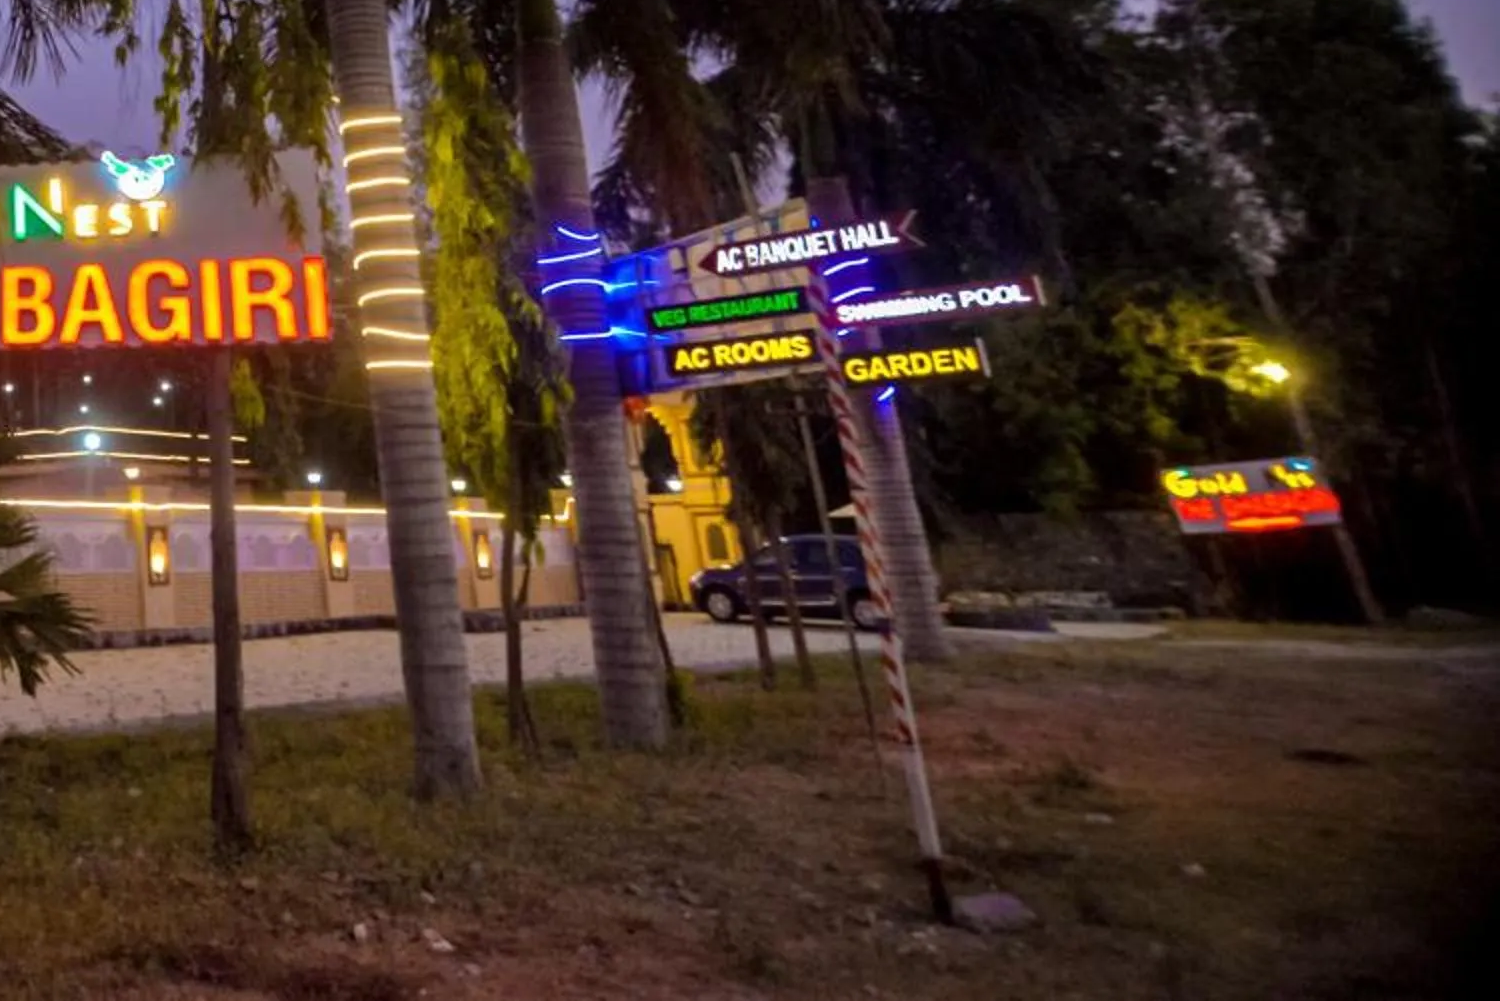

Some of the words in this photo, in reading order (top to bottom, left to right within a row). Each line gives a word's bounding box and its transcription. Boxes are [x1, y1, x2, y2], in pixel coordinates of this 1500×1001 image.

[716, 246, 744, 273] AC
[744, 230, 838, 267] BANQUET
[839, 220, 900, 251] HALL
[688, 291, 799, 323] RESTAURANT
[836, 292, 957, 324] SWIMMING
[958, 284, 1033, 309] POOL
[674, 346, 710, 371] AC
[712, 335, 813, 367] ROOMS
[844, 346, 980, 382] GARDEN
